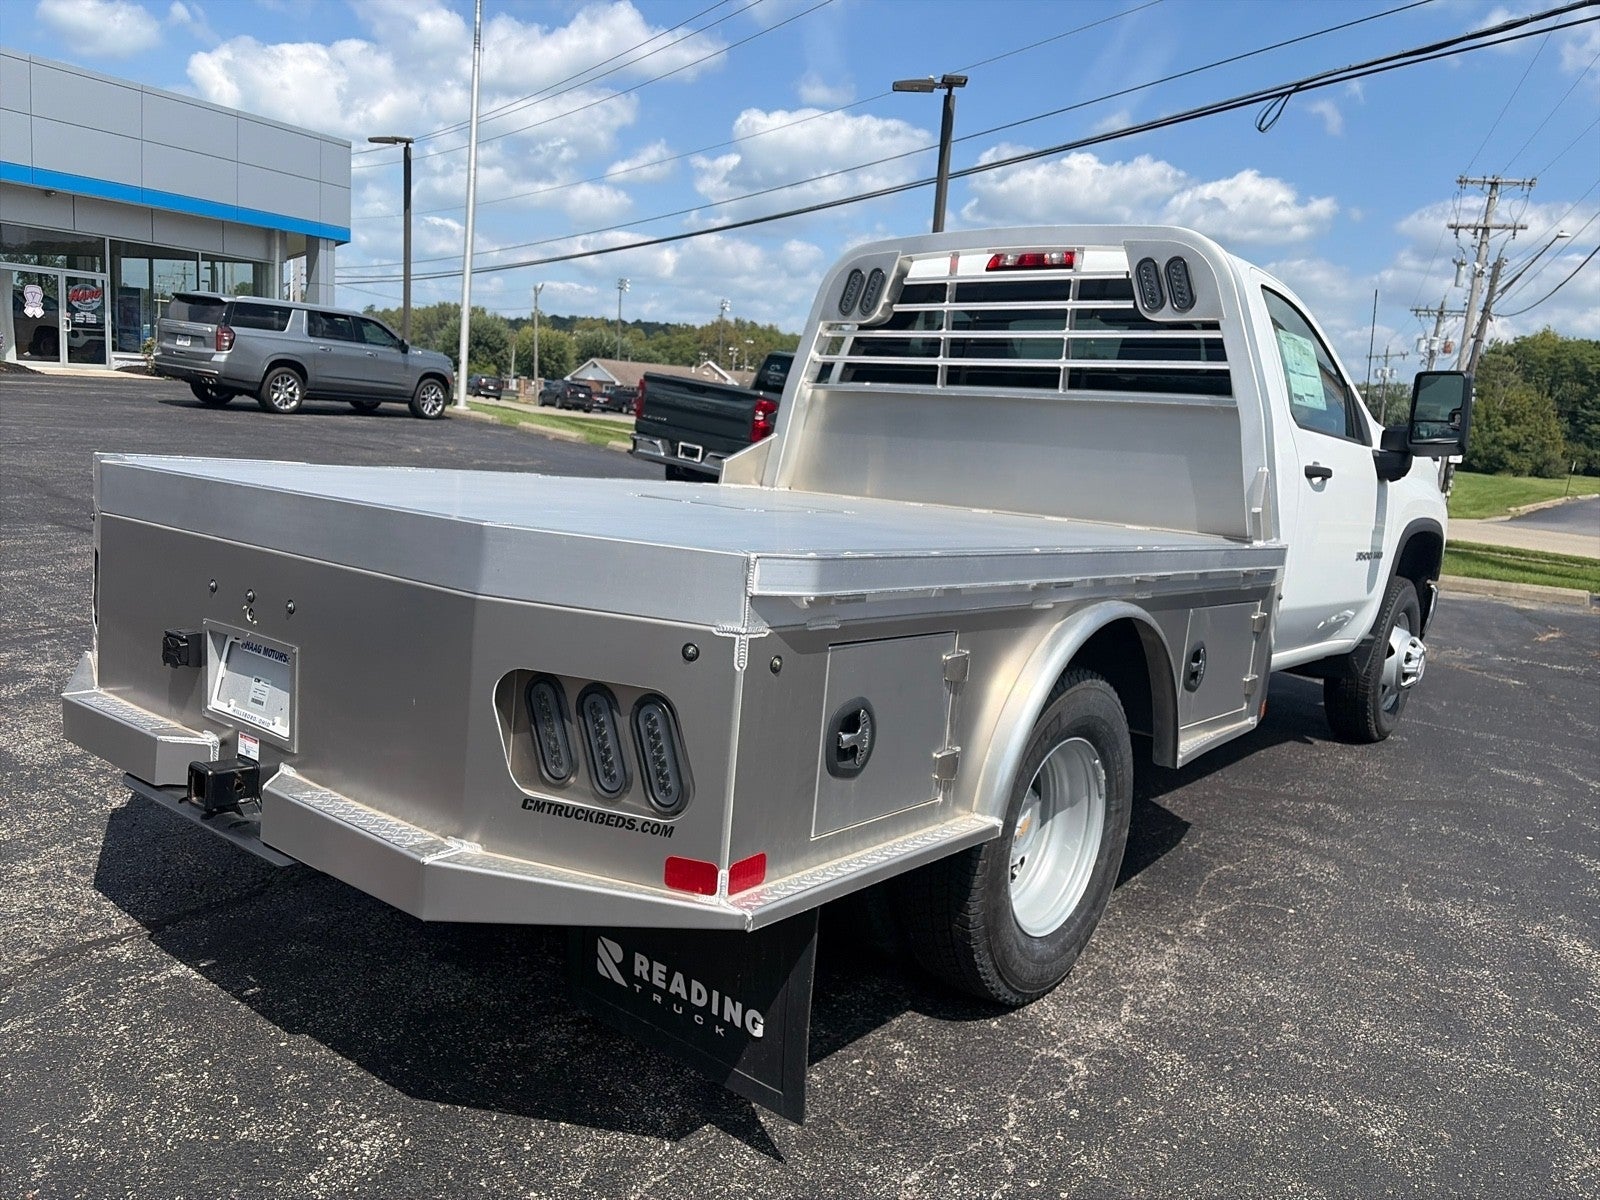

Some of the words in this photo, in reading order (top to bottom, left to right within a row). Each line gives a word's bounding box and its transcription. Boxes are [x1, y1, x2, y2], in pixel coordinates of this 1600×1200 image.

[245, 641, 262, 654] HAAG
[262, 646, 288, 663] MOTORS
[521, 798, 675, 838] CMTRUCKBEDS.COM
[633, 951, 764, 1038] READING
[633, 983, 725, 1038] TRUCK
